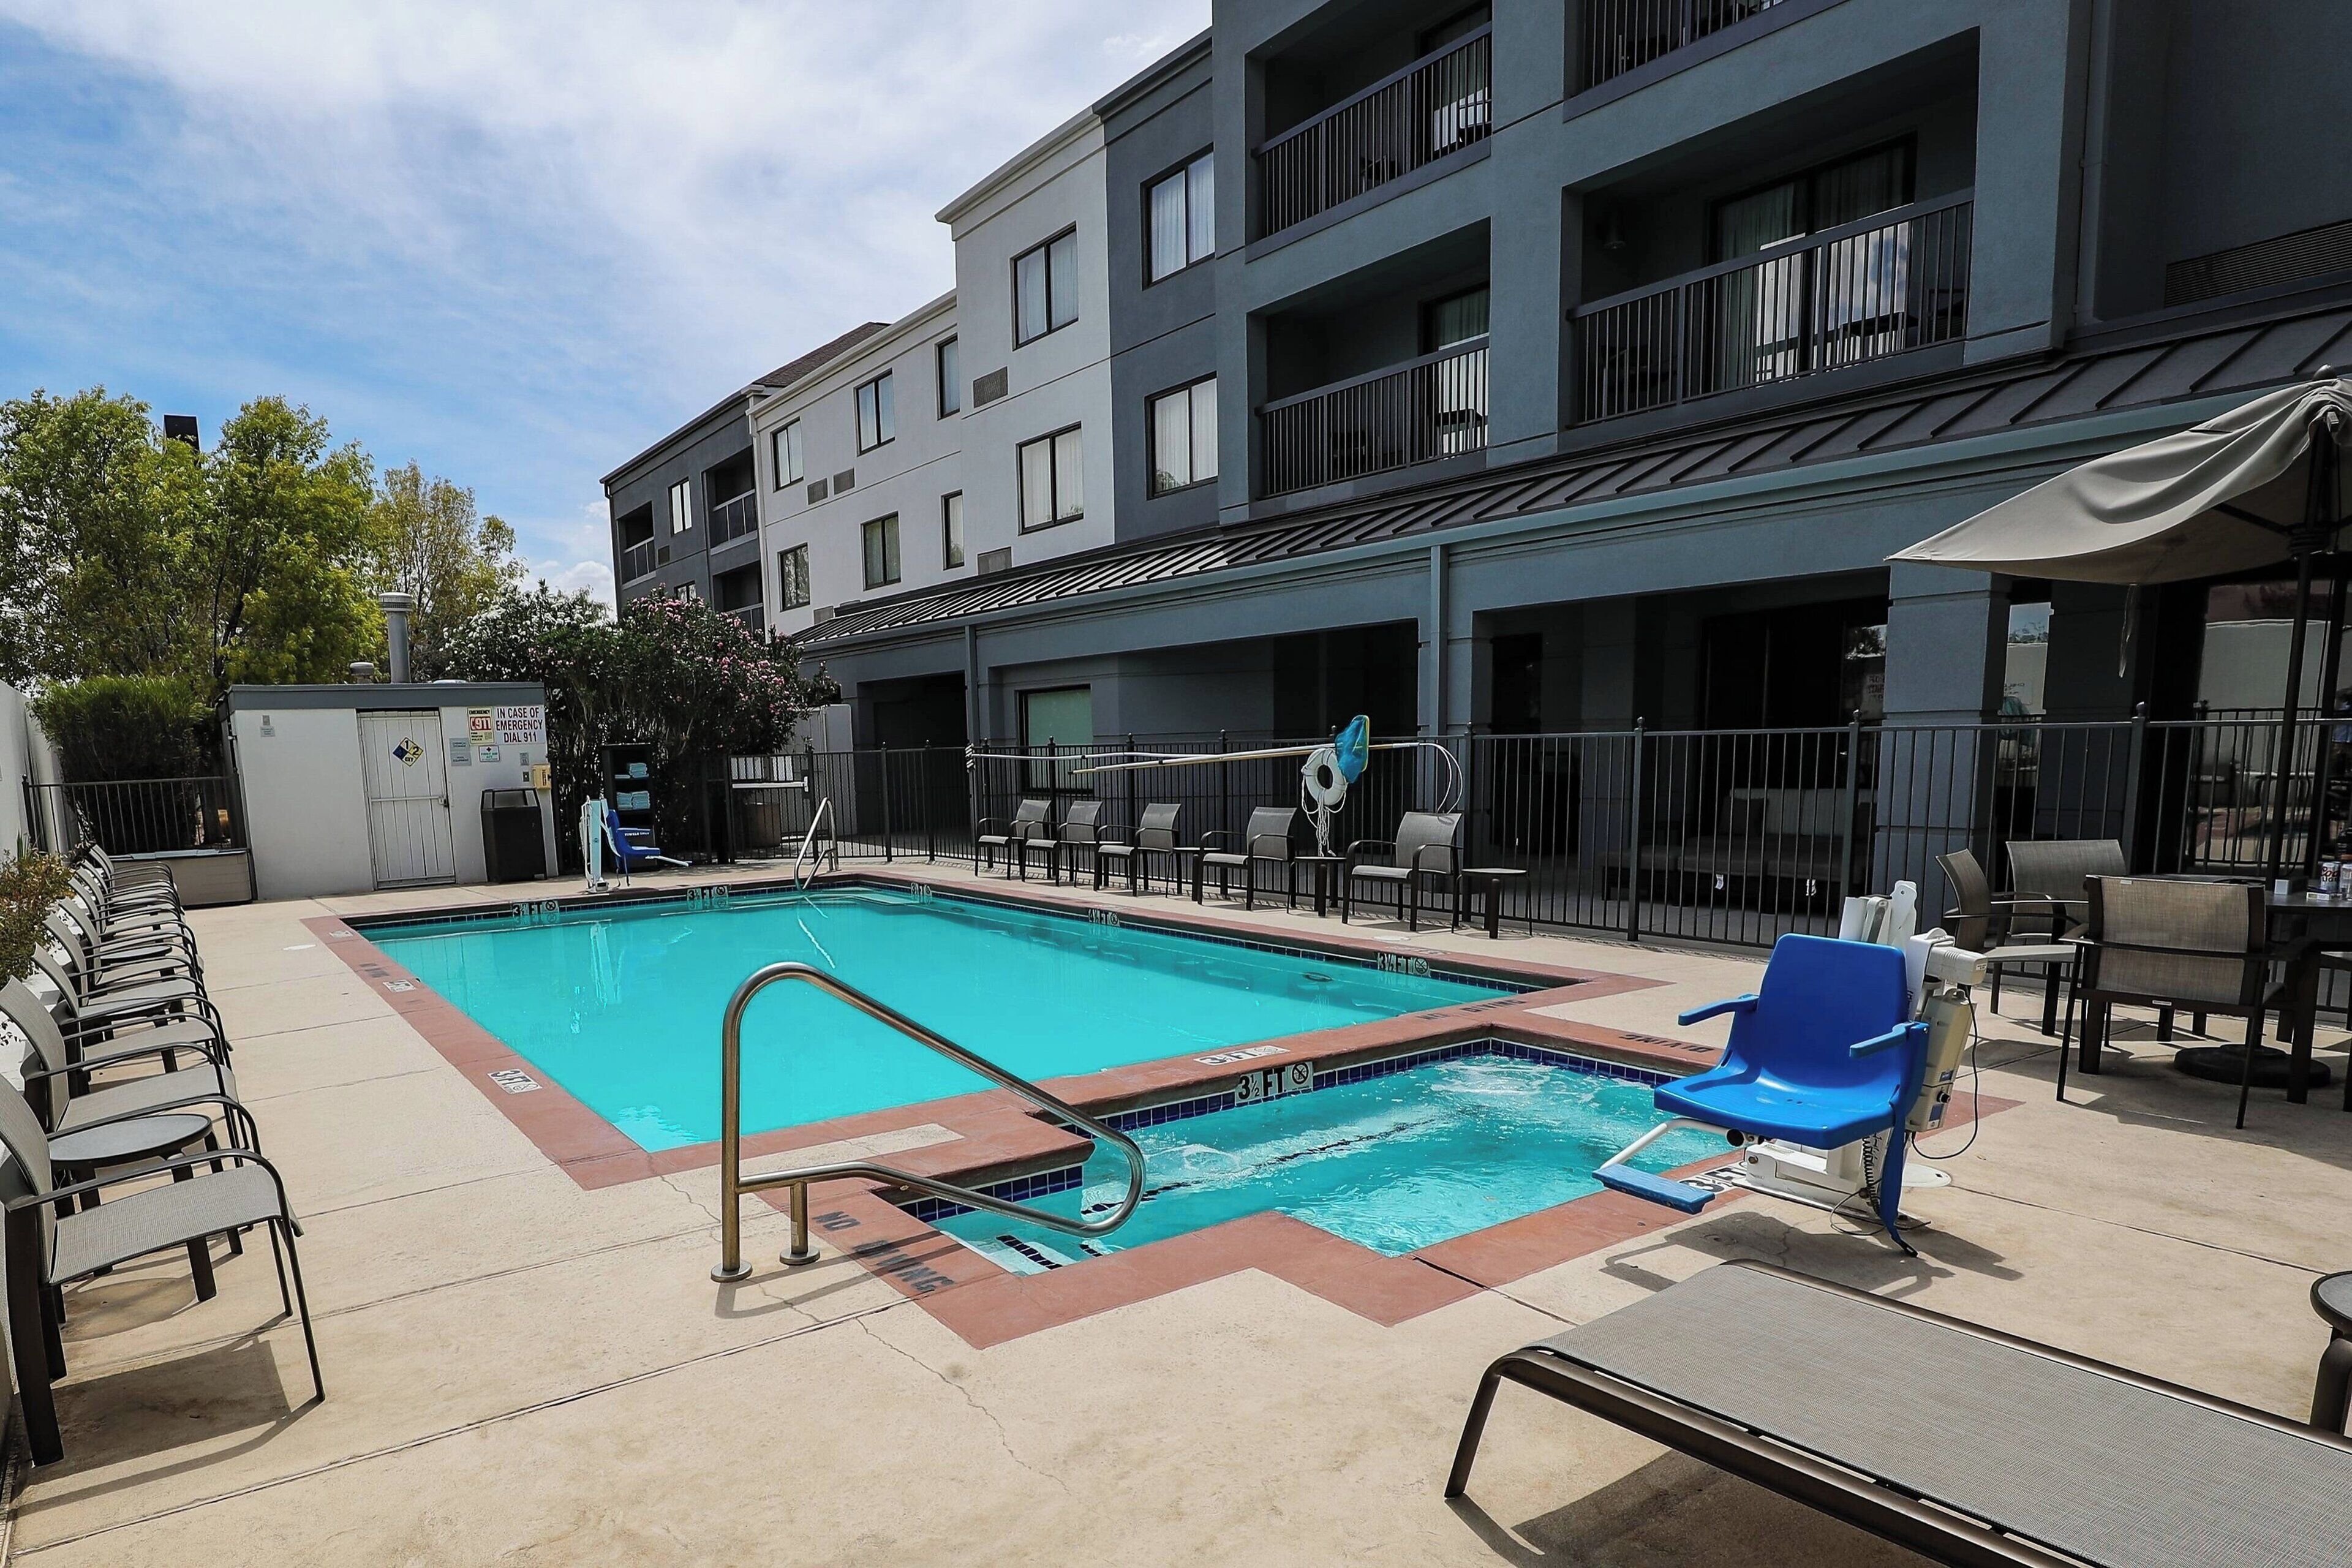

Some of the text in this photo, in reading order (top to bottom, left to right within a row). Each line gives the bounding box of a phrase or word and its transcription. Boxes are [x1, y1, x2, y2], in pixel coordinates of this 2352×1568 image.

[497, 707, 540, 718] IN CASE OF
[475, 717, 491, 729] 911
[496, 720, 543, 731] EMERGENCY
[503, 732, 537, 743] DIAL 911
[404, 740, 409, 750] 1
[412, 746, 420, 756] 2
[701, 886, 712, 900] FT
[1396, 955, 1410, 974] FT
[1618, 1034, 1714, 1054] DIVING
[1262, 1066, 1286, 1097] FT
[812, 1210, 861, 1232] NO
